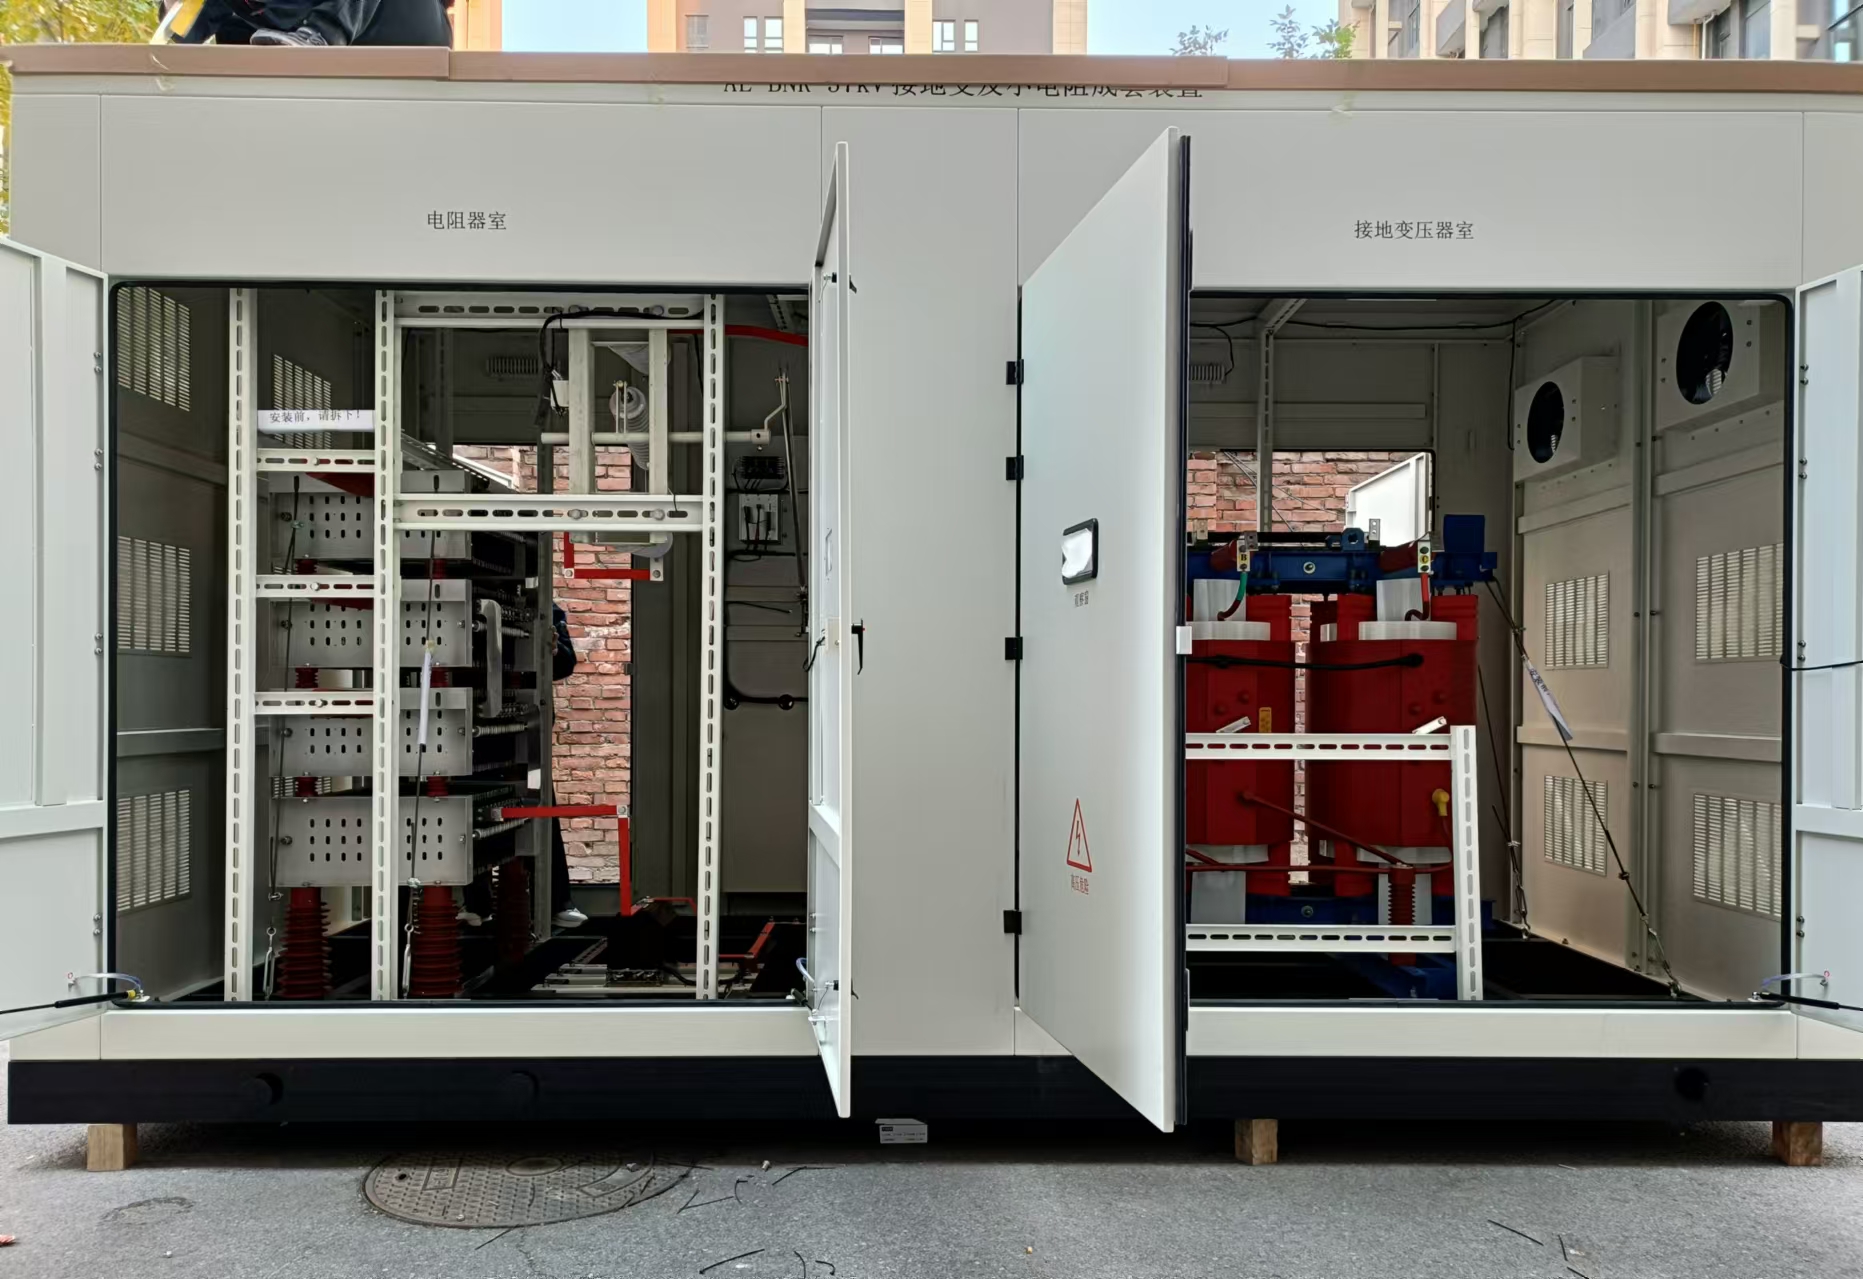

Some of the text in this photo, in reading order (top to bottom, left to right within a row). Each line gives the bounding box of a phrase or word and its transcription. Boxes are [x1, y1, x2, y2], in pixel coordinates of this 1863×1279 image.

[427, 210, 507, 230] 电阻器室
[1354, 220, 1474, 240] 接地变压器室
